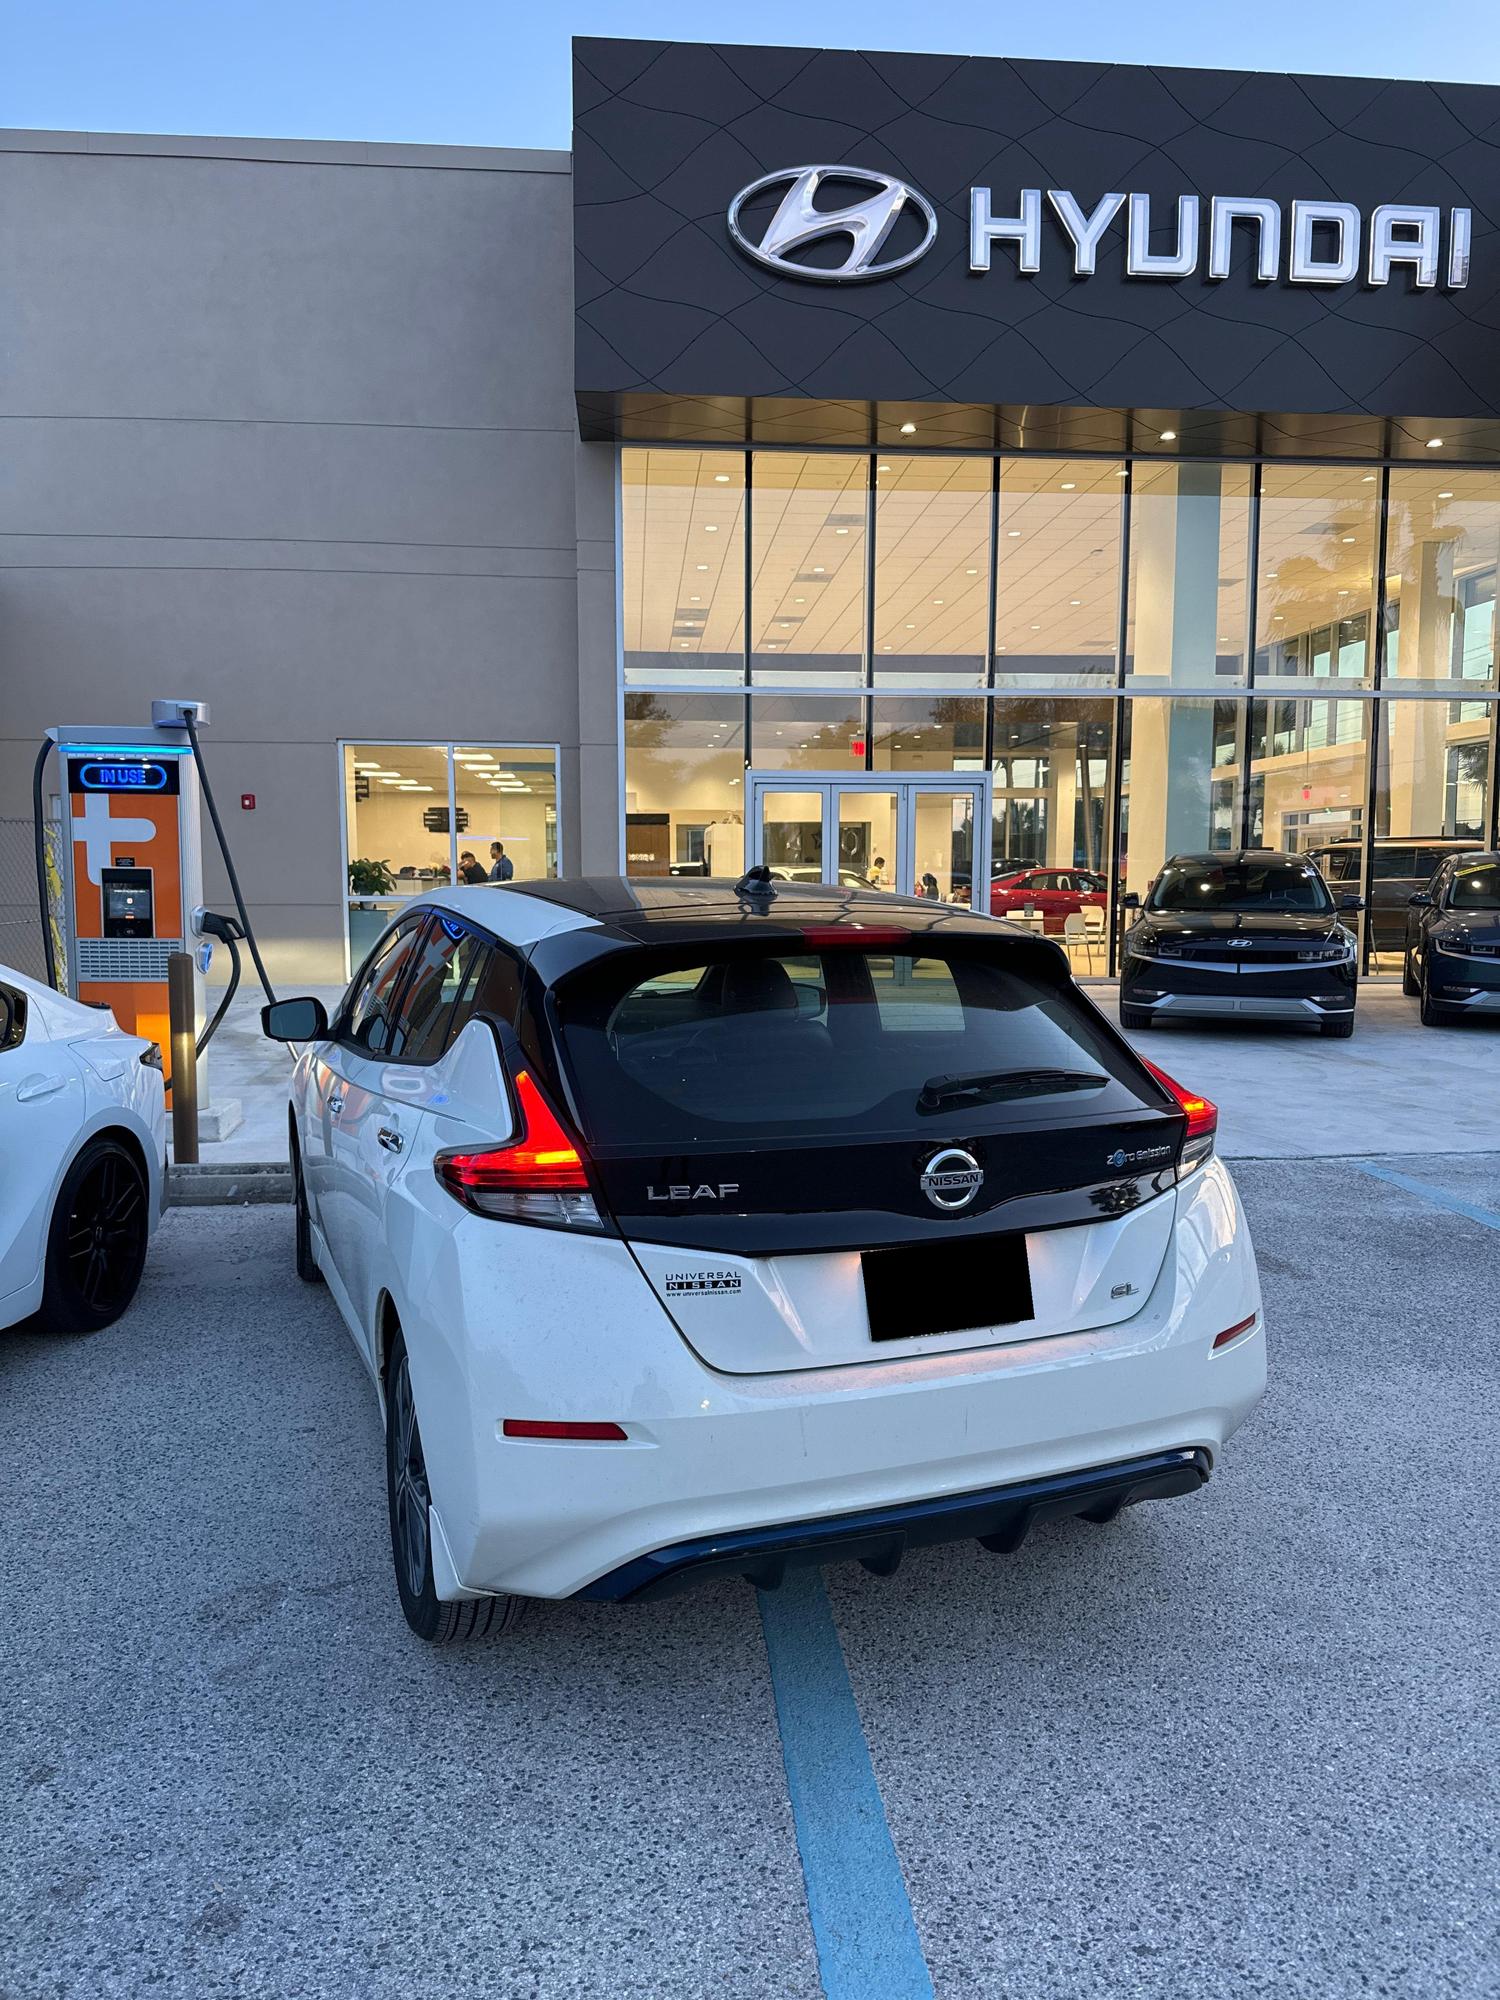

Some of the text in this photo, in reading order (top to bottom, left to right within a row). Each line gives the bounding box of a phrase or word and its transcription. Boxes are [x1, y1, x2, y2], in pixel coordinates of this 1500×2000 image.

[969, 186, 1472, 289] HYUNDAI
[100, 769, 147, 784] IN USE
[928, 1173, 979, 1187] NISSAN
[646, 1183, 740, 1201] LEAF
[665, 1271, 742, 1281] UNIVERSAL
[668, 1279, 739, 1290] NISSAN
